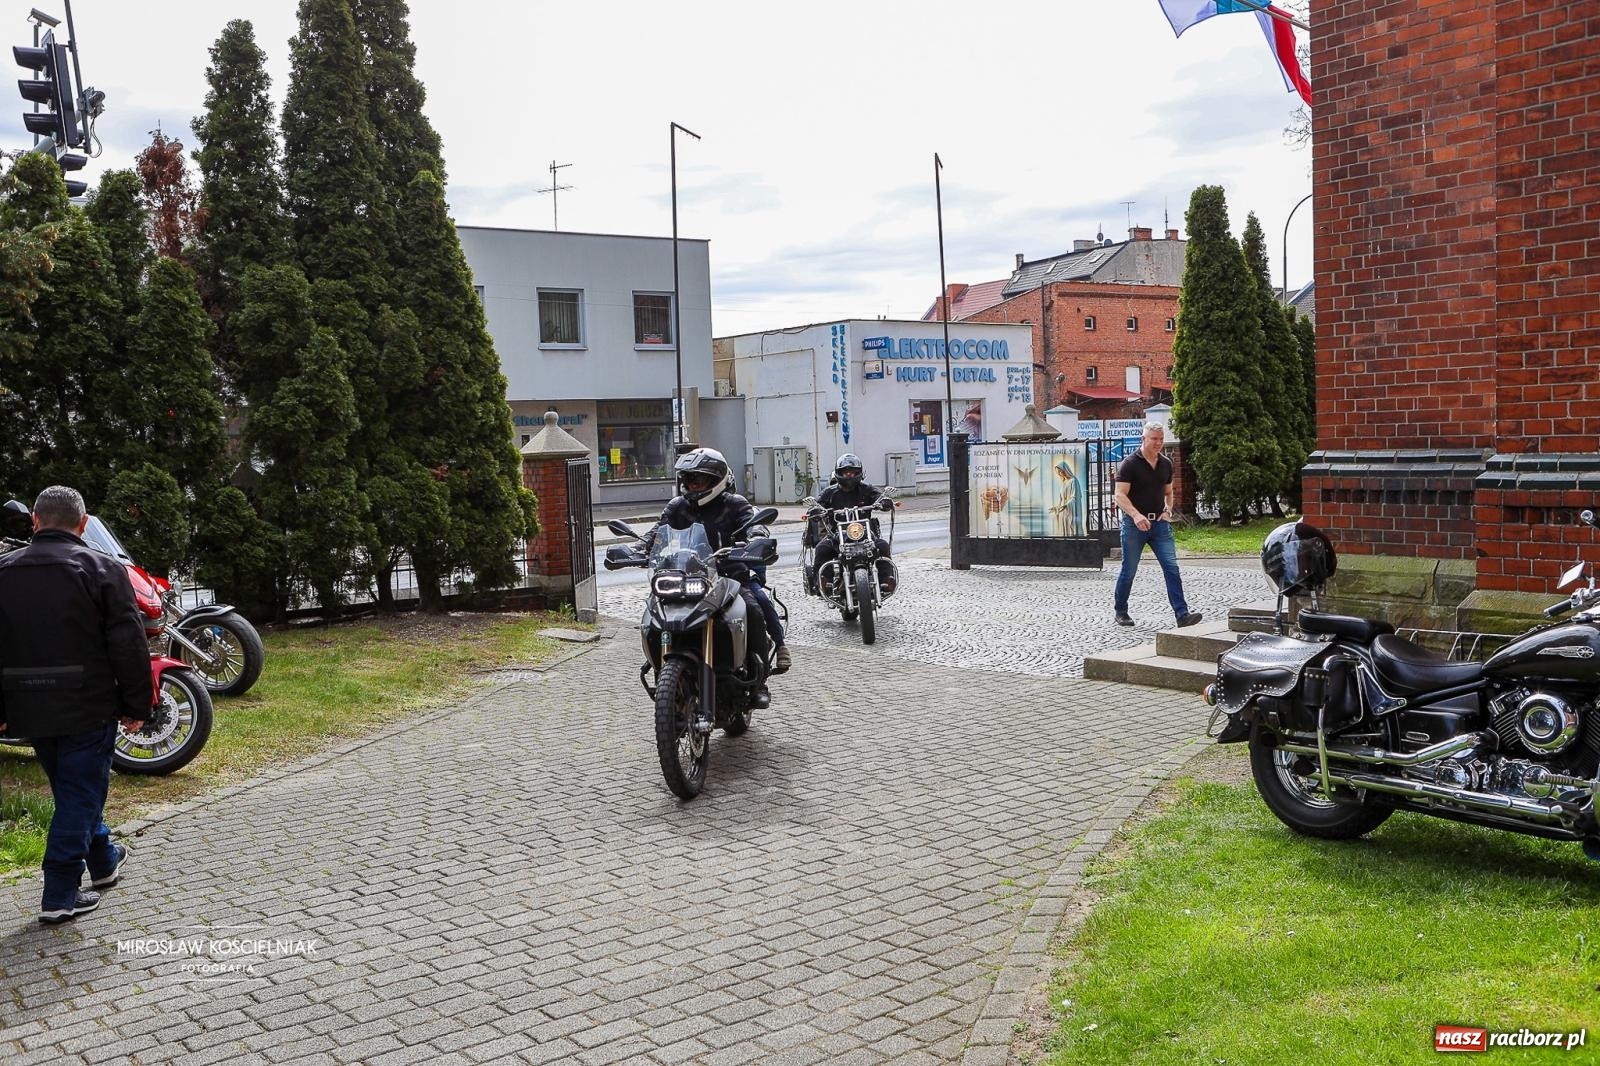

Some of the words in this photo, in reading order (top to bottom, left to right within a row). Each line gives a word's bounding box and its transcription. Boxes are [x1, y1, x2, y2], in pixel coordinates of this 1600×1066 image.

[864, 339, 886, 348] PHILIPS
[896, 366, 937, 383] HURT
[953, 367, 997, 383] DETAL
[839, 324, 850, 445] ELEKTRYCZNY
[1109, 421, 1143, 429] HURTOWNIA
[1107, 429, 1143, 437] ELEKTRYCZN
